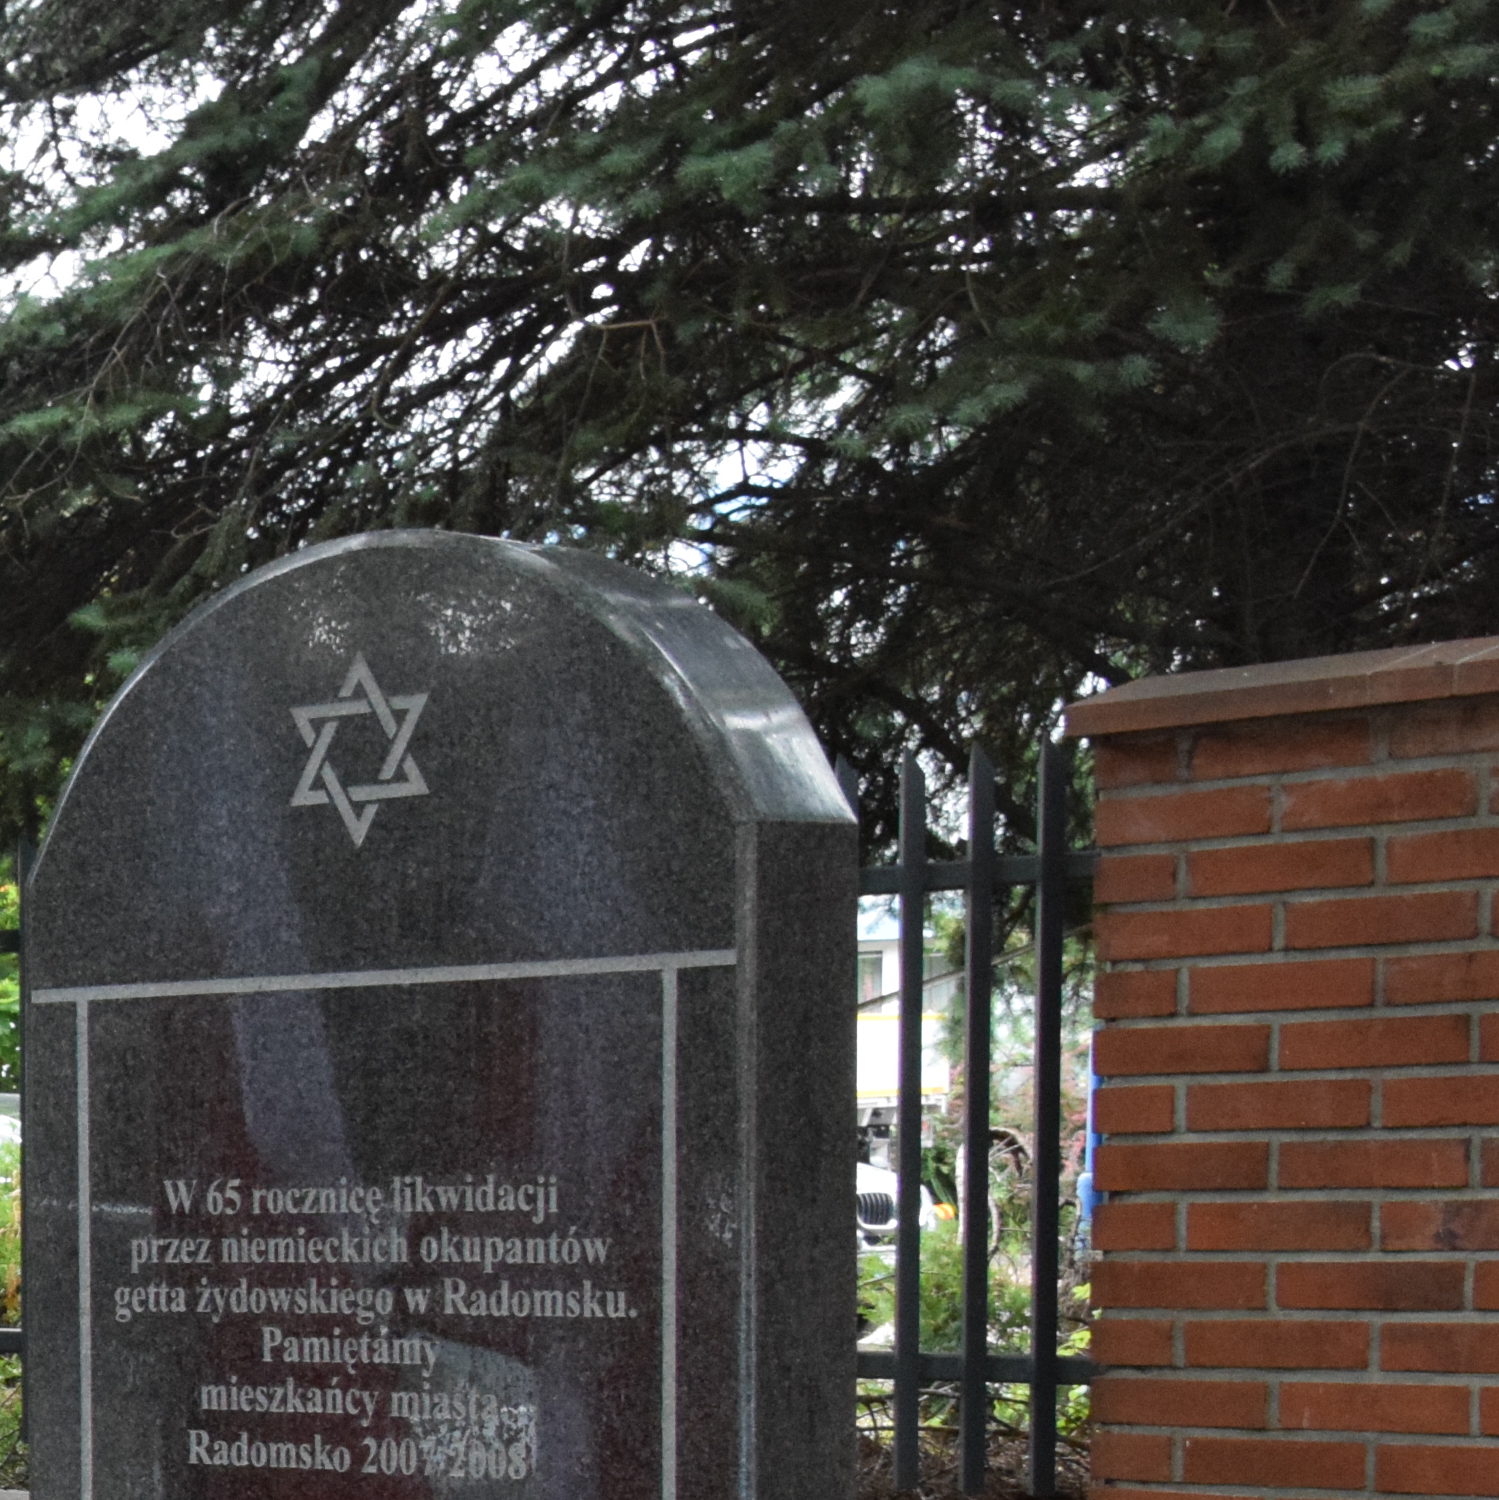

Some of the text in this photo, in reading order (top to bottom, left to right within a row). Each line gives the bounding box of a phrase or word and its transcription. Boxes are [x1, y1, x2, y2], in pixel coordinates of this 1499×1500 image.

[163, 1174, 559, 1224] W 65 rocznicę likwidacji
[130, 1226, 612, 1273] przez niemieckich okupantów
[114, 1277, 638, 1324] getta żydowskiego w Radomsku.
[261, 1327, 440, 1377] Pamiętamy
[201, 1375, 501, 1427] mieszkańcy miasta
[187, 1429, 351, 1472] Radomsko
